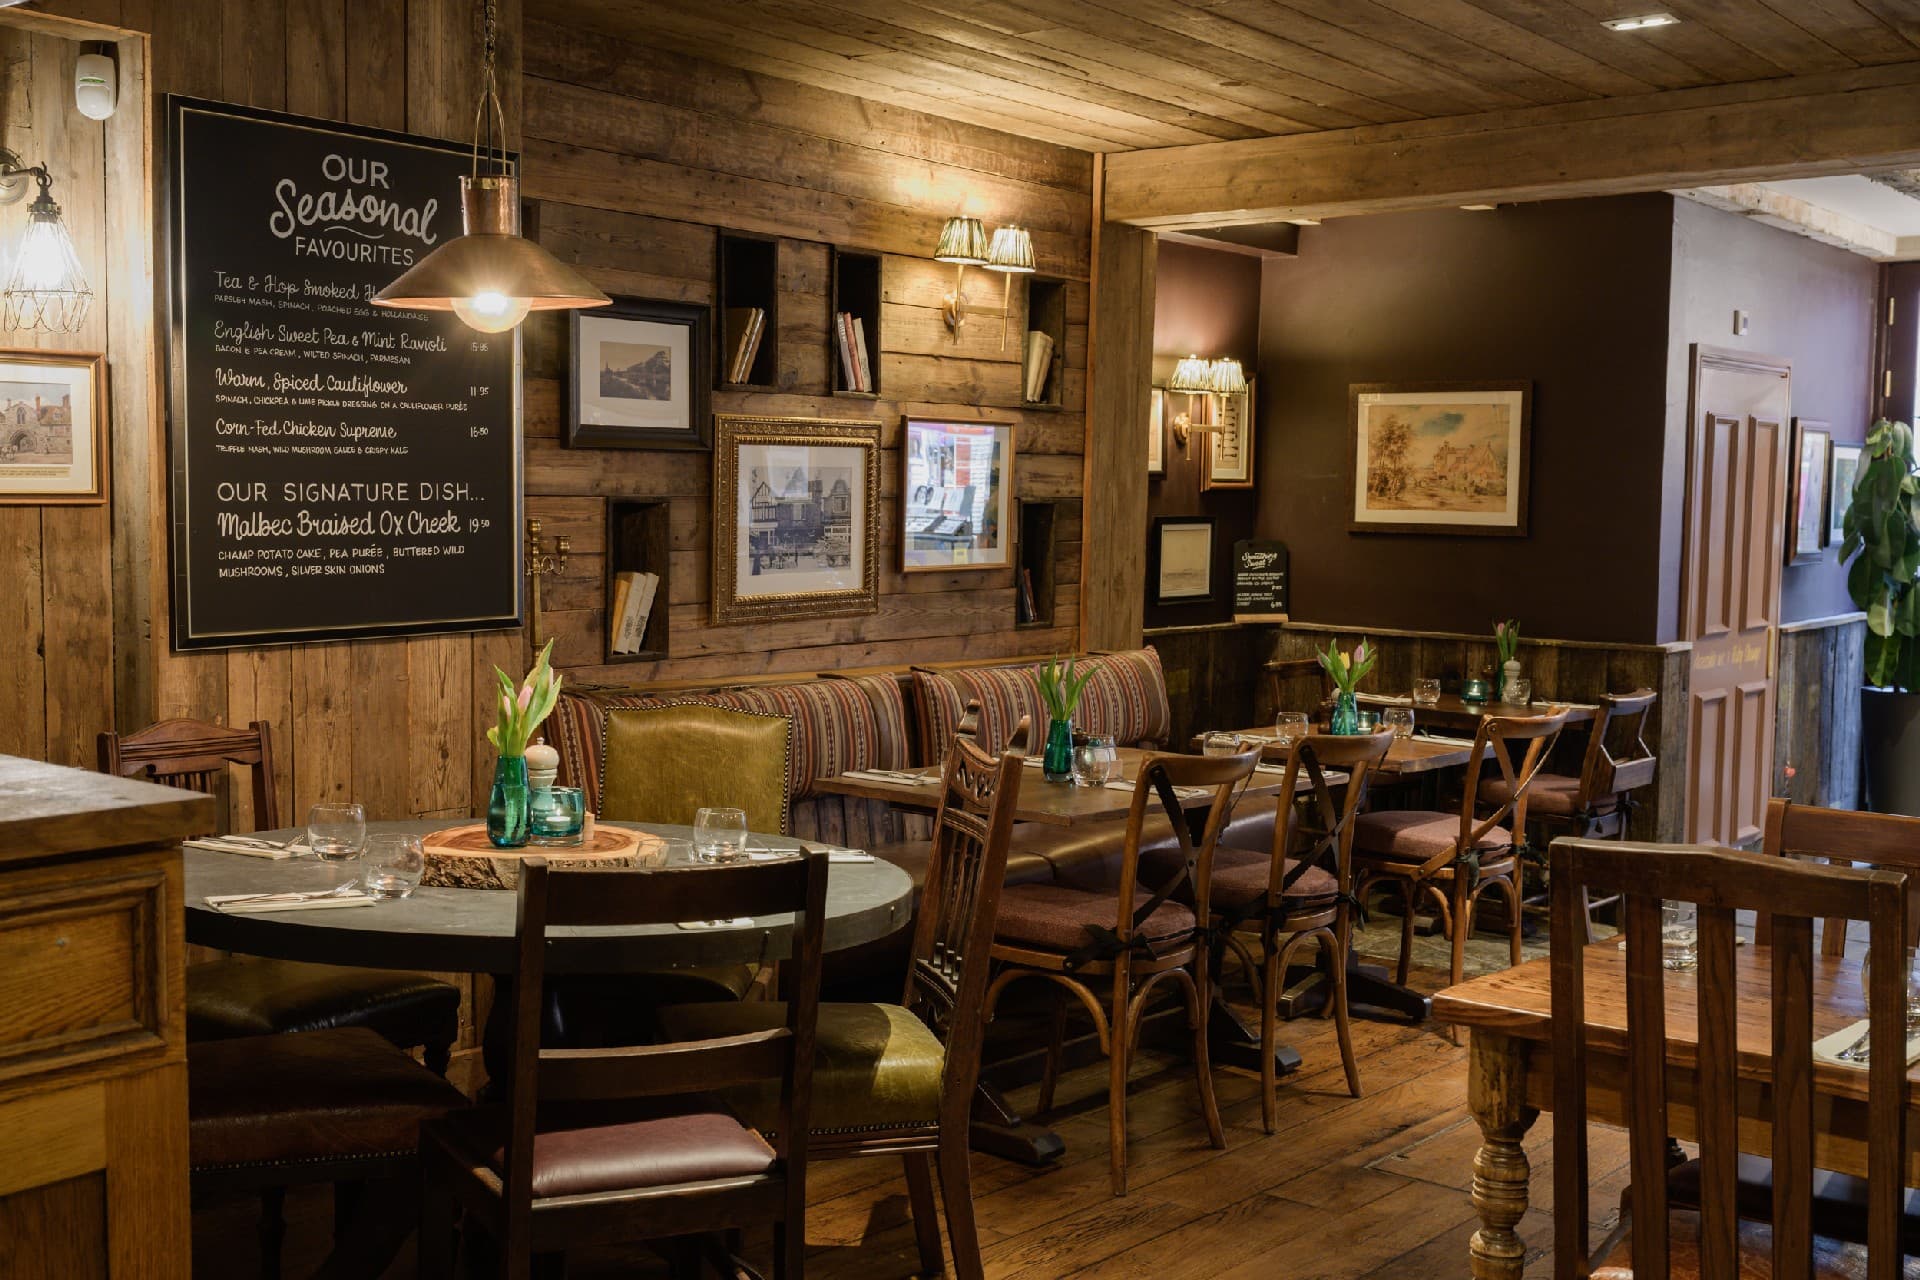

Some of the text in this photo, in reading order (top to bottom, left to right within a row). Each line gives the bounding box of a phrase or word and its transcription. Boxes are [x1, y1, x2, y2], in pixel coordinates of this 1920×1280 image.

[322, 154, 389, 190] OUR
[270, 178, 438, 245] Seasonal
[295, 236, 414, 266] FAVOURITES
[214, 270, 242, 289] Tea
[248, 275, 260, 290] &
[264, 274, 300, 300] Hop
[303, 278, 360, 300] Smoked
[214, 319, 275, 345] English
[278, 324, 320, 344] Sweet
[323, 327, 350, 345] Pea
[361, 331, 396, 349] Mint
[400, 332, 447, 352] Ravioli
[273, 372, 325, 394] Spiced
[326, 374, 408, 398] Cauliflower
[215, 417, 398, 442] Corn-Fed Chicken Supreme
[217, 482, 485, 502] OUR SIGNATURE DISH...
[217, 509, 461, 540] Malbec Braised Ox Cheek
[218, 550, 254, 560] CHAMP
[257, 549, 294, 560] POTATO
[329, 548, 349, 558] PEA
[393, 546, 440, 557] BUTTERED
[442, 545, 465, 555] WILD
[291, 565, 322, 576] SILVER
[324, 564, 346, 576] SKIN
[349, 564, 385, 575] ONIONS
